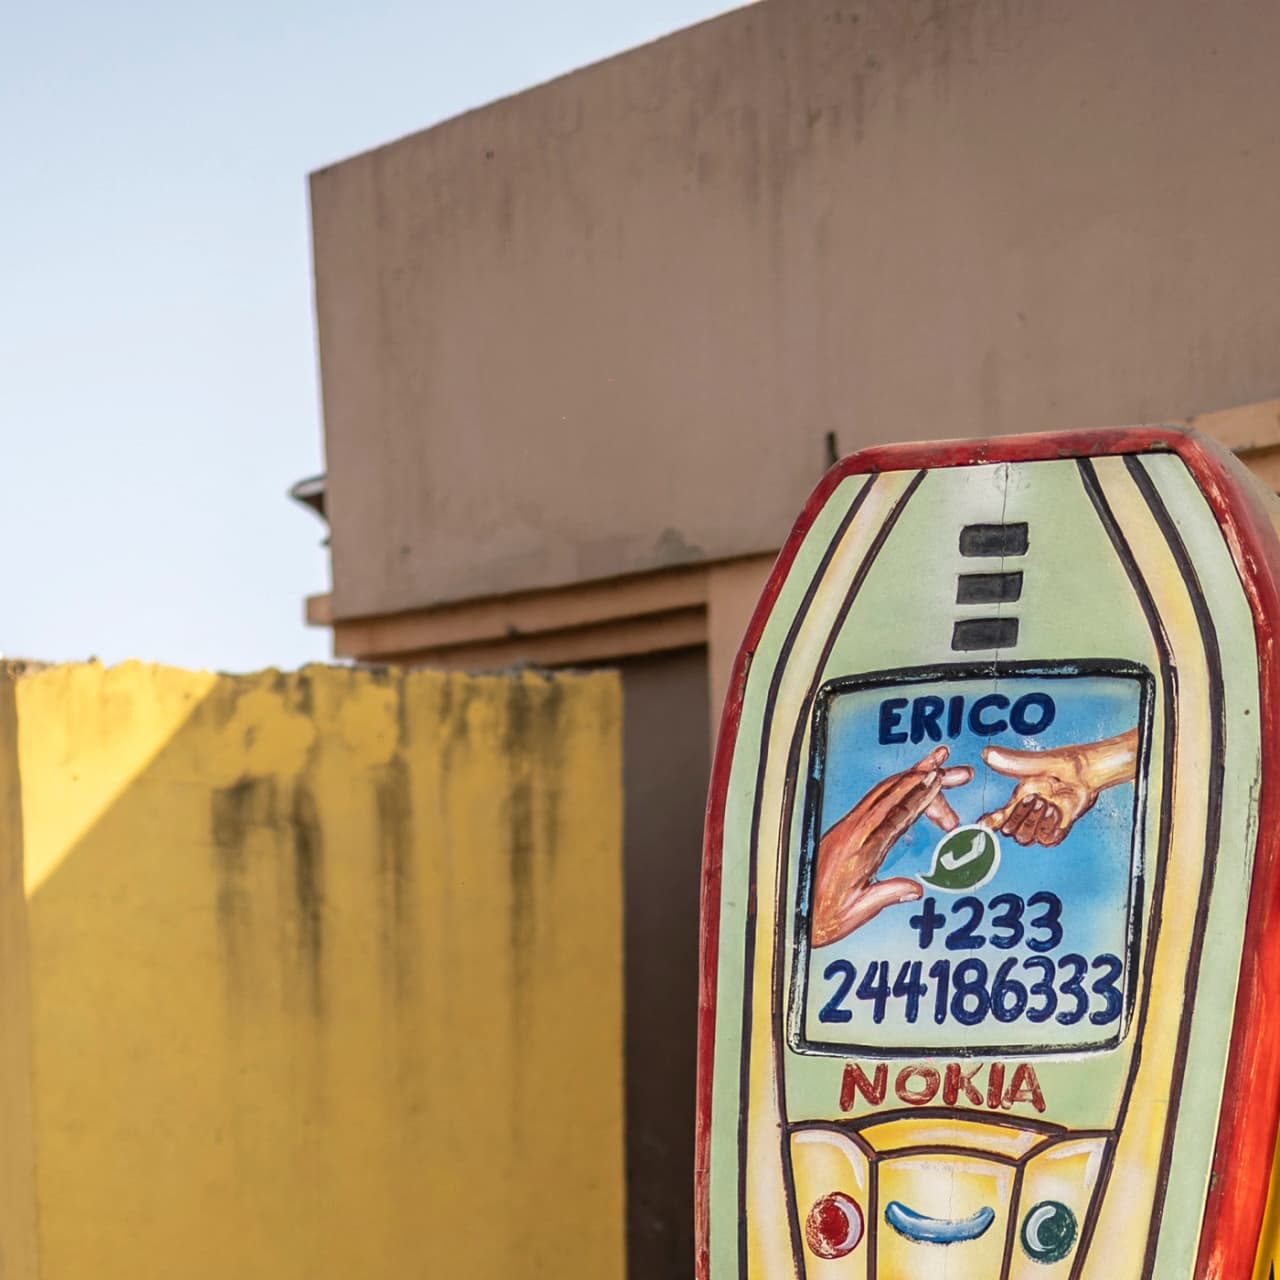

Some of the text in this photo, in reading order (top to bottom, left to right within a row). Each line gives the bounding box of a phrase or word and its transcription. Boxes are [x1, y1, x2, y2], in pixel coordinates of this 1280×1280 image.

[879, 693, 1056, 745] ERICO
[910, 892, 1063, 950] +233
[819, 954, 1123, 1025] 244186333
[839, 1062, 1046, 1112] NOKIA
